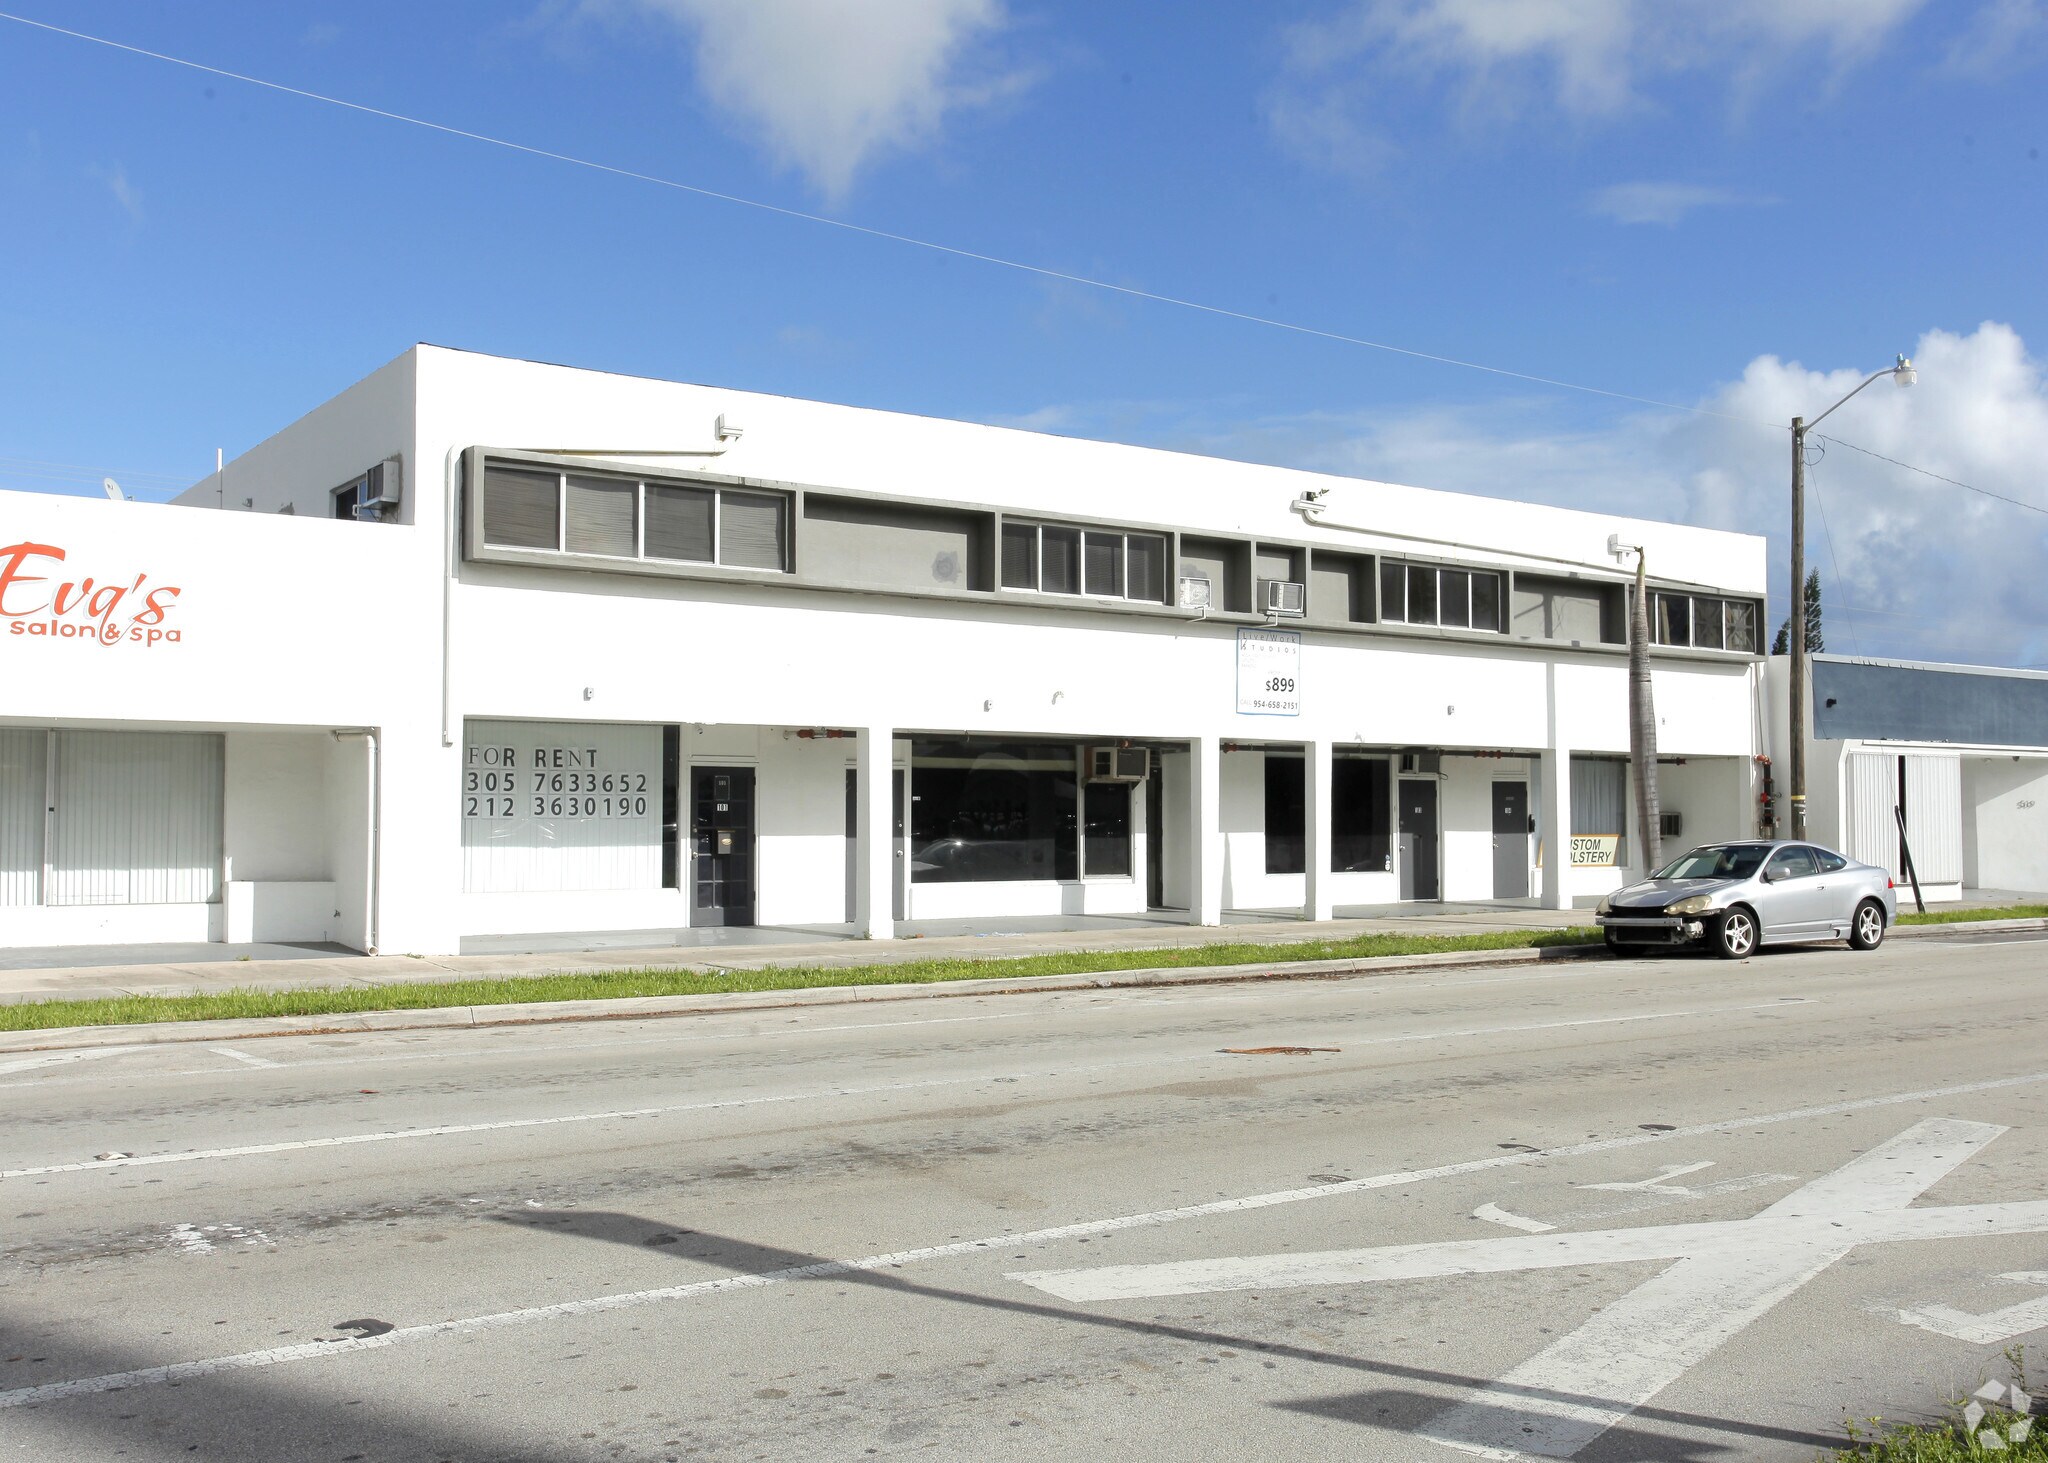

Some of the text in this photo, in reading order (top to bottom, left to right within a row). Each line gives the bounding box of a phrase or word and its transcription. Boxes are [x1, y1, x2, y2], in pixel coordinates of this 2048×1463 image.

[0, 541, 181, 646] Eva's
[10, 619, 181, 647] salon & spa
[1242, 632, 1296, 643] Live/Work
[1265, 677, 1295, 692] $899
[468, 747, 597, 767] FOR RENT
[467, 772, 647, 793] 305 7633652
[467, 797, 647, 817] 212 3630190
[1570, 839, 1601, 851] STOM
[1570, 851, 1611, 863] LSTERY
